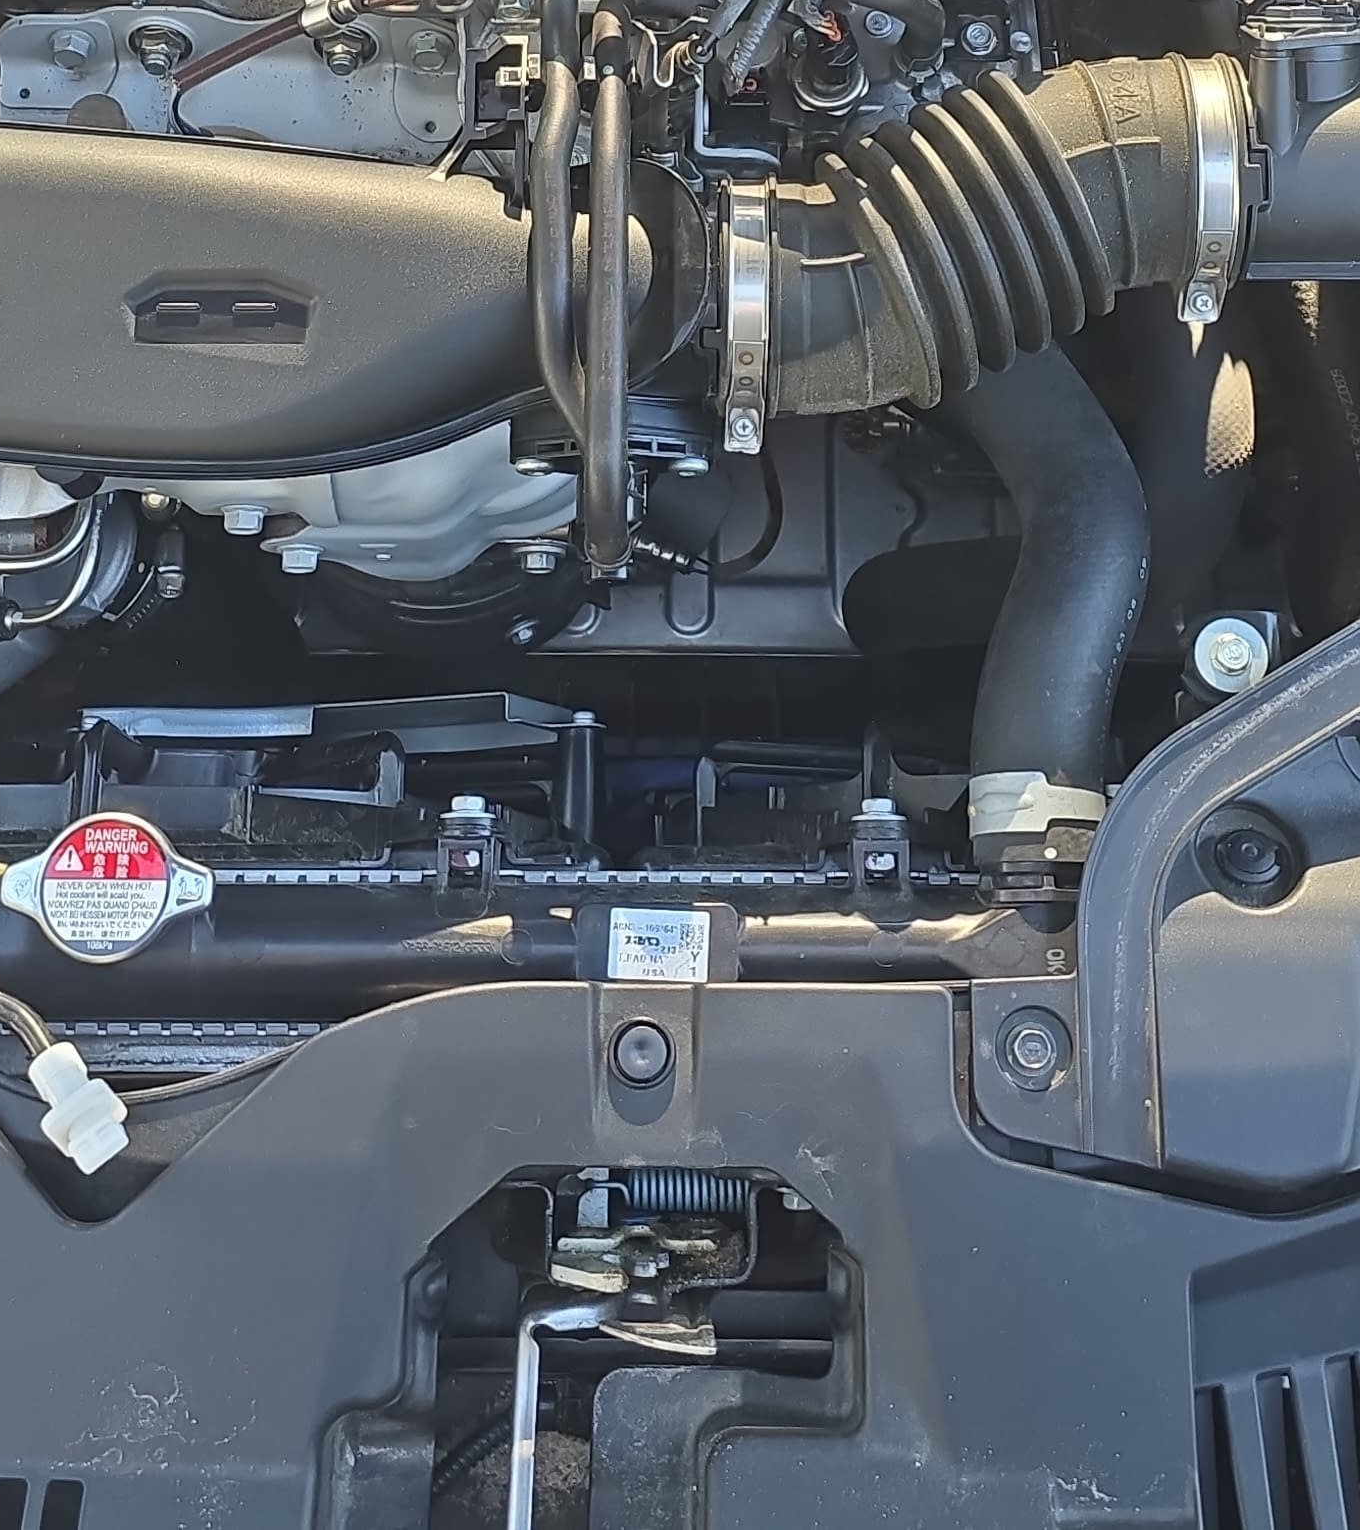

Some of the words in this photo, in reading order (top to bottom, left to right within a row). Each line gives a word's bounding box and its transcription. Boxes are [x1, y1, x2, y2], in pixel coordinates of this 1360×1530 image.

[85, 828, 138, 841] DANGER
[85, 841, 149, 854] WARNUNG
[57, 881, 84, 890] NEVER
[85, 881, 107, 890] OPEN
[109, 882, 133, 890] WHEN
[56, 891, 69, 899] Hot
[86, 901, 101, 909] PAS
[103, 901, 129, 909] QUAND
[131, 901, 157, 910] CHAUD
